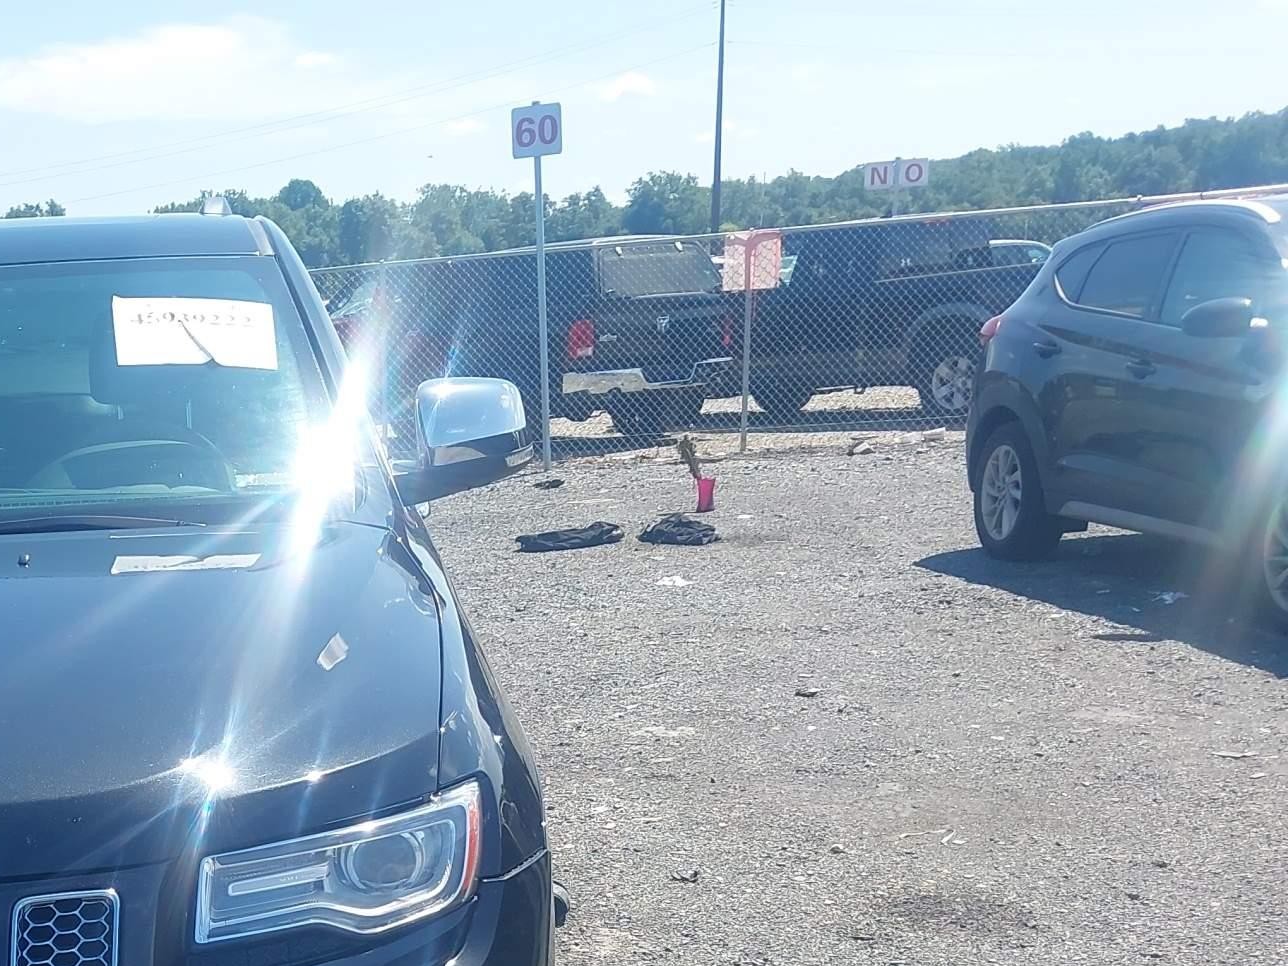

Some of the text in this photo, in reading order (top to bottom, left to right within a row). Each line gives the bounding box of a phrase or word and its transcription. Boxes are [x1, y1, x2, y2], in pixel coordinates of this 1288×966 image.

[515, 114, 558, 148] 60
[870, 163, 923, 186] N O
